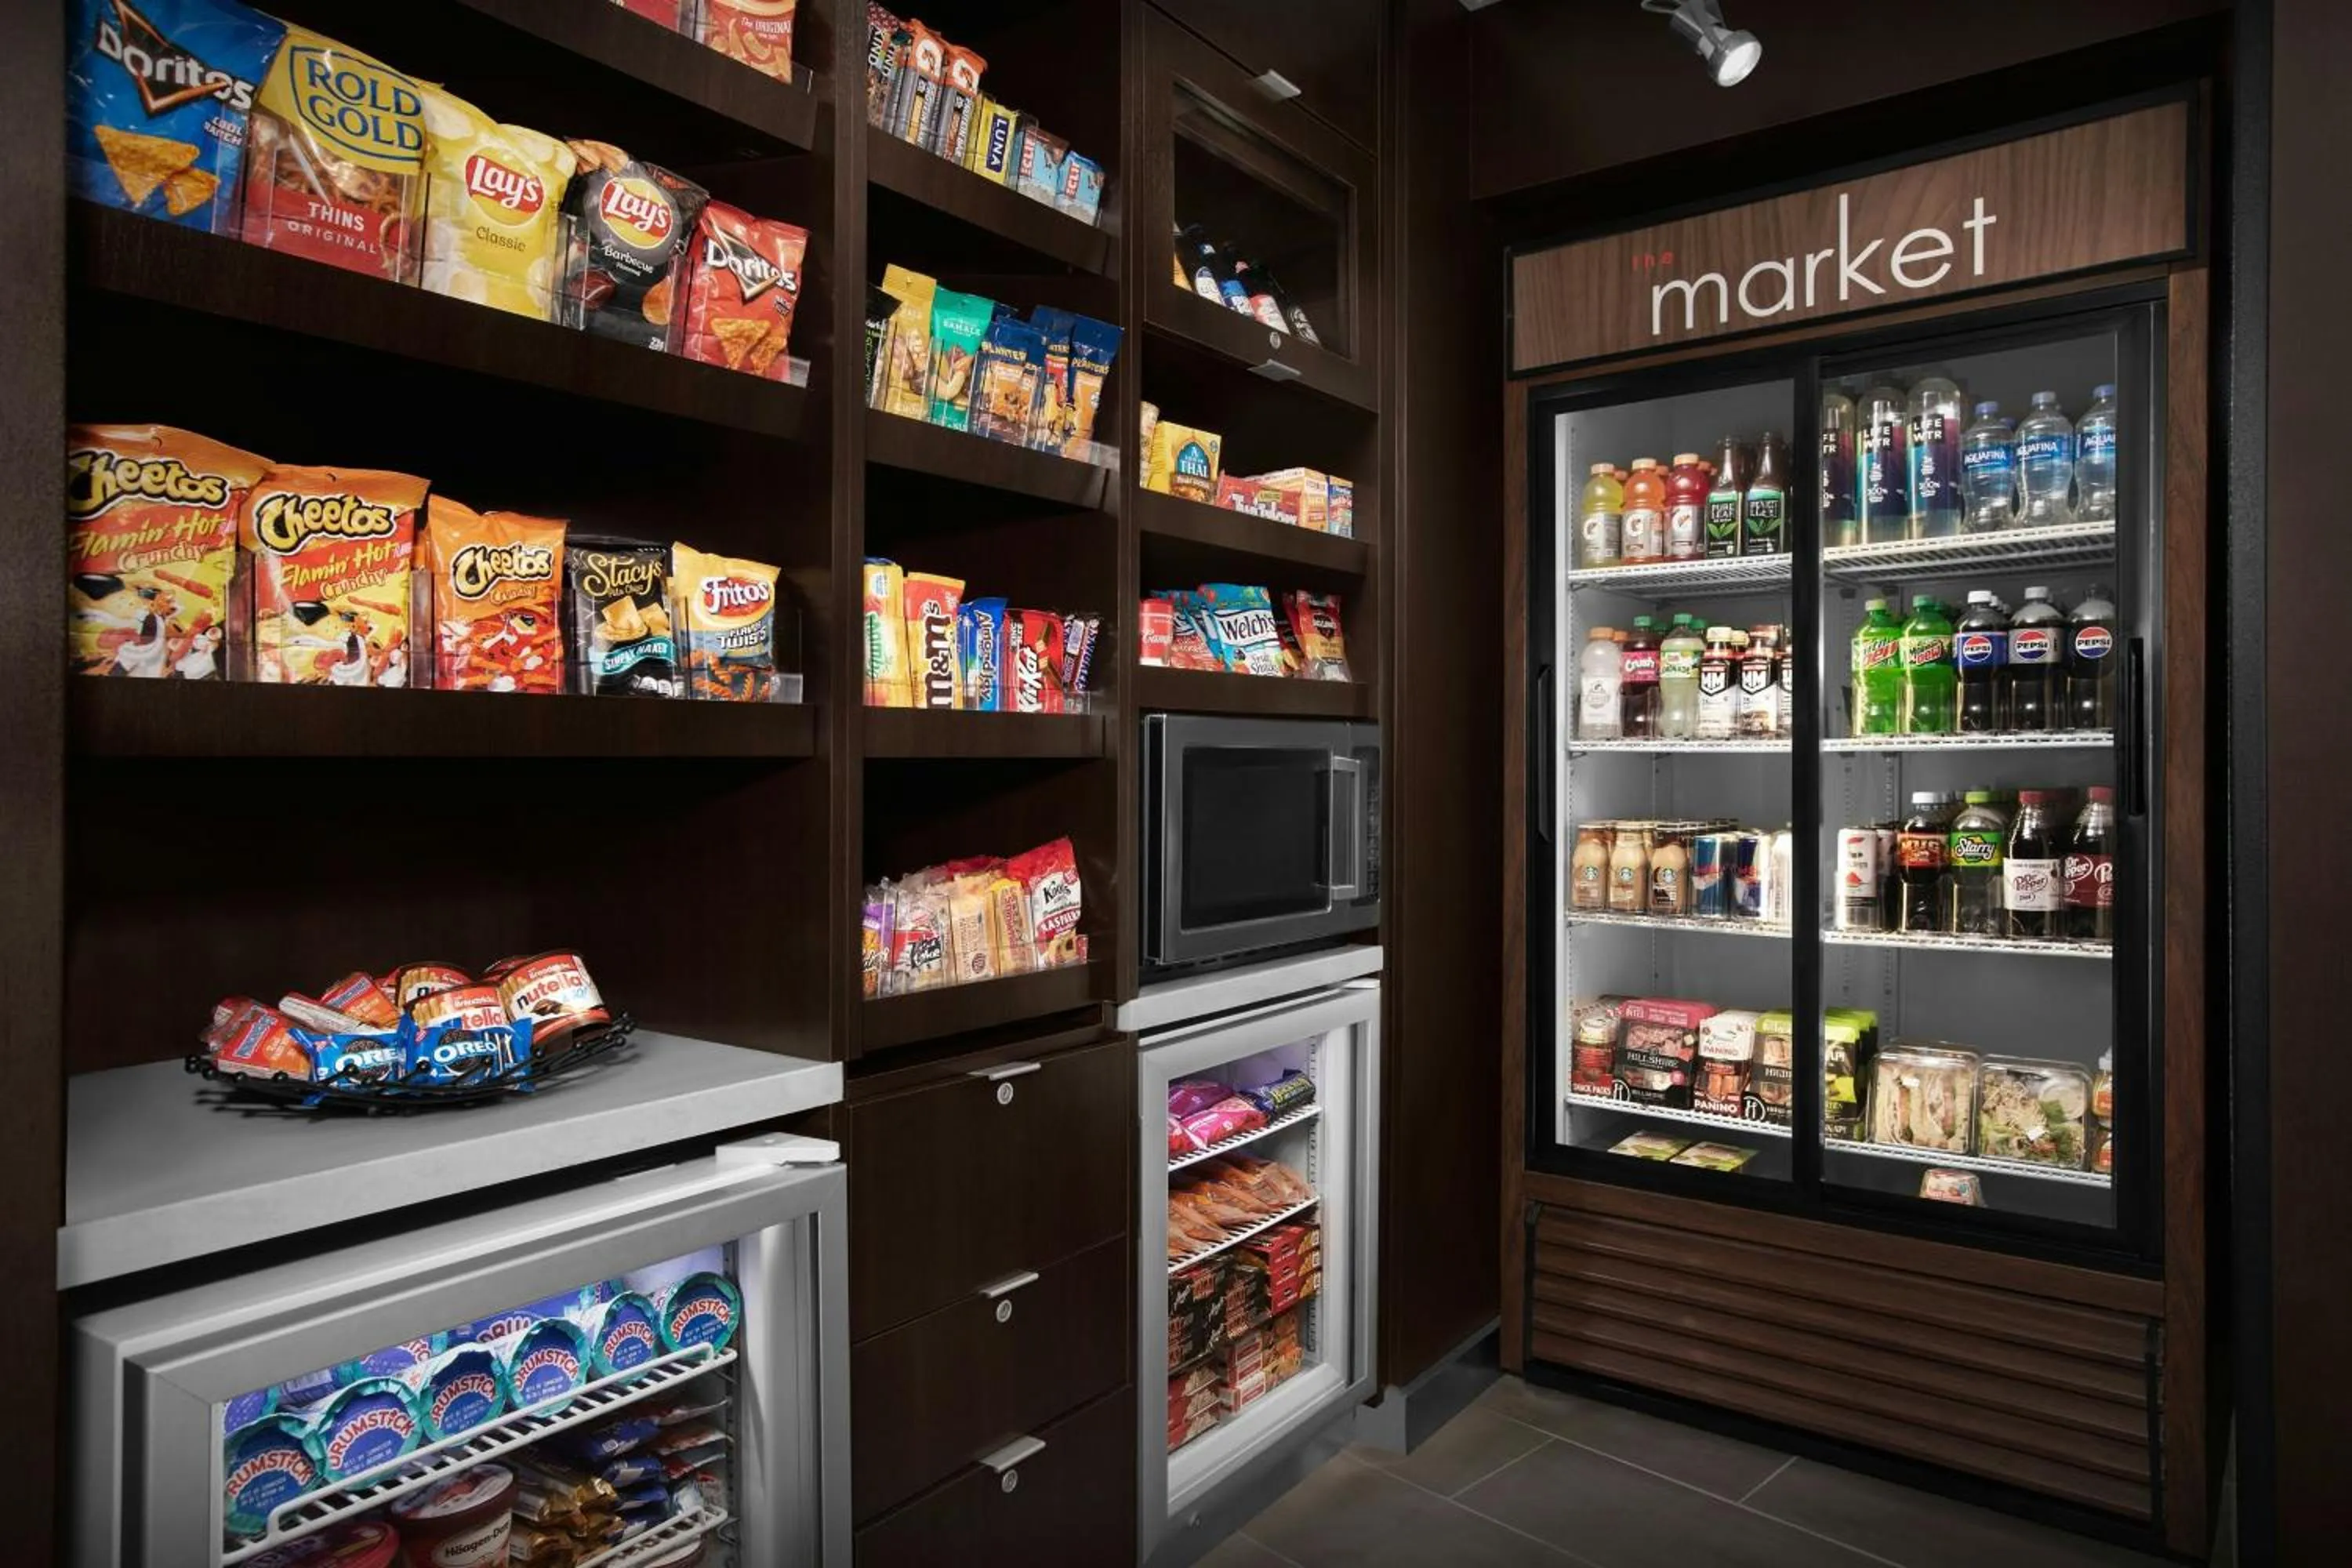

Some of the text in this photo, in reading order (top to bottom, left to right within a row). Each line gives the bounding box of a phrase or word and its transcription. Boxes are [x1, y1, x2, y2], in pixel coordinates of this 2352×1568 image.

[868, 26, 884, 67] KIND
[99, 22, 256, 110] Doritos
[303, 57, 422, 117] ROLD
[308, 93, 423, 152] GOLD
[991, 118, 1008, 167] LUNA
[470, 156, 540, 206] Lay's
[307, 200, 365, 232] THINS
[607, 185, 670, 232] Lay's
[287, 220, 378, 256] ORIGINAL
[475, 226, 527, 252] Classic
[603, 244, 654, 274] Barbecue
[706, 238, 797, 292] Doritos
[1651, 193, 1998, 336] market
[1964, 451, 2007, 465] AQUAFINA
[2016, 441, 2058, 456] AQUAFINA
[68, 451, 228, 516] Cheetos
[1181, 459, 1207, 478] THAI
[173, 511, 226, 541] Hot
[256, 494, 394, 551] Cheetos
[119, 540, 209, 572] Crunchy
[280, 543, 394, 588] Flamin' Hot
[453, 546, 553, 597] Cheetos
[319, 568, 390, 600] Crunchy
[583, 553, 663, 597] Stacy's
[701, 575, 769, 614] Fritos
[1220, 612, 1277, 641] Welch's
[2078, 638, 2111, 647] PEPSI
[1624, 656, 1656, 671] Crush
[1955, 835, 1995, 860] Starry
[517, 972, 583, 1011] nutella
[461, 1007, 503, 1029] tella
[434, 1040, 497, 1065] OREO
[1693, 1098, 1739, 1114] PANINO
